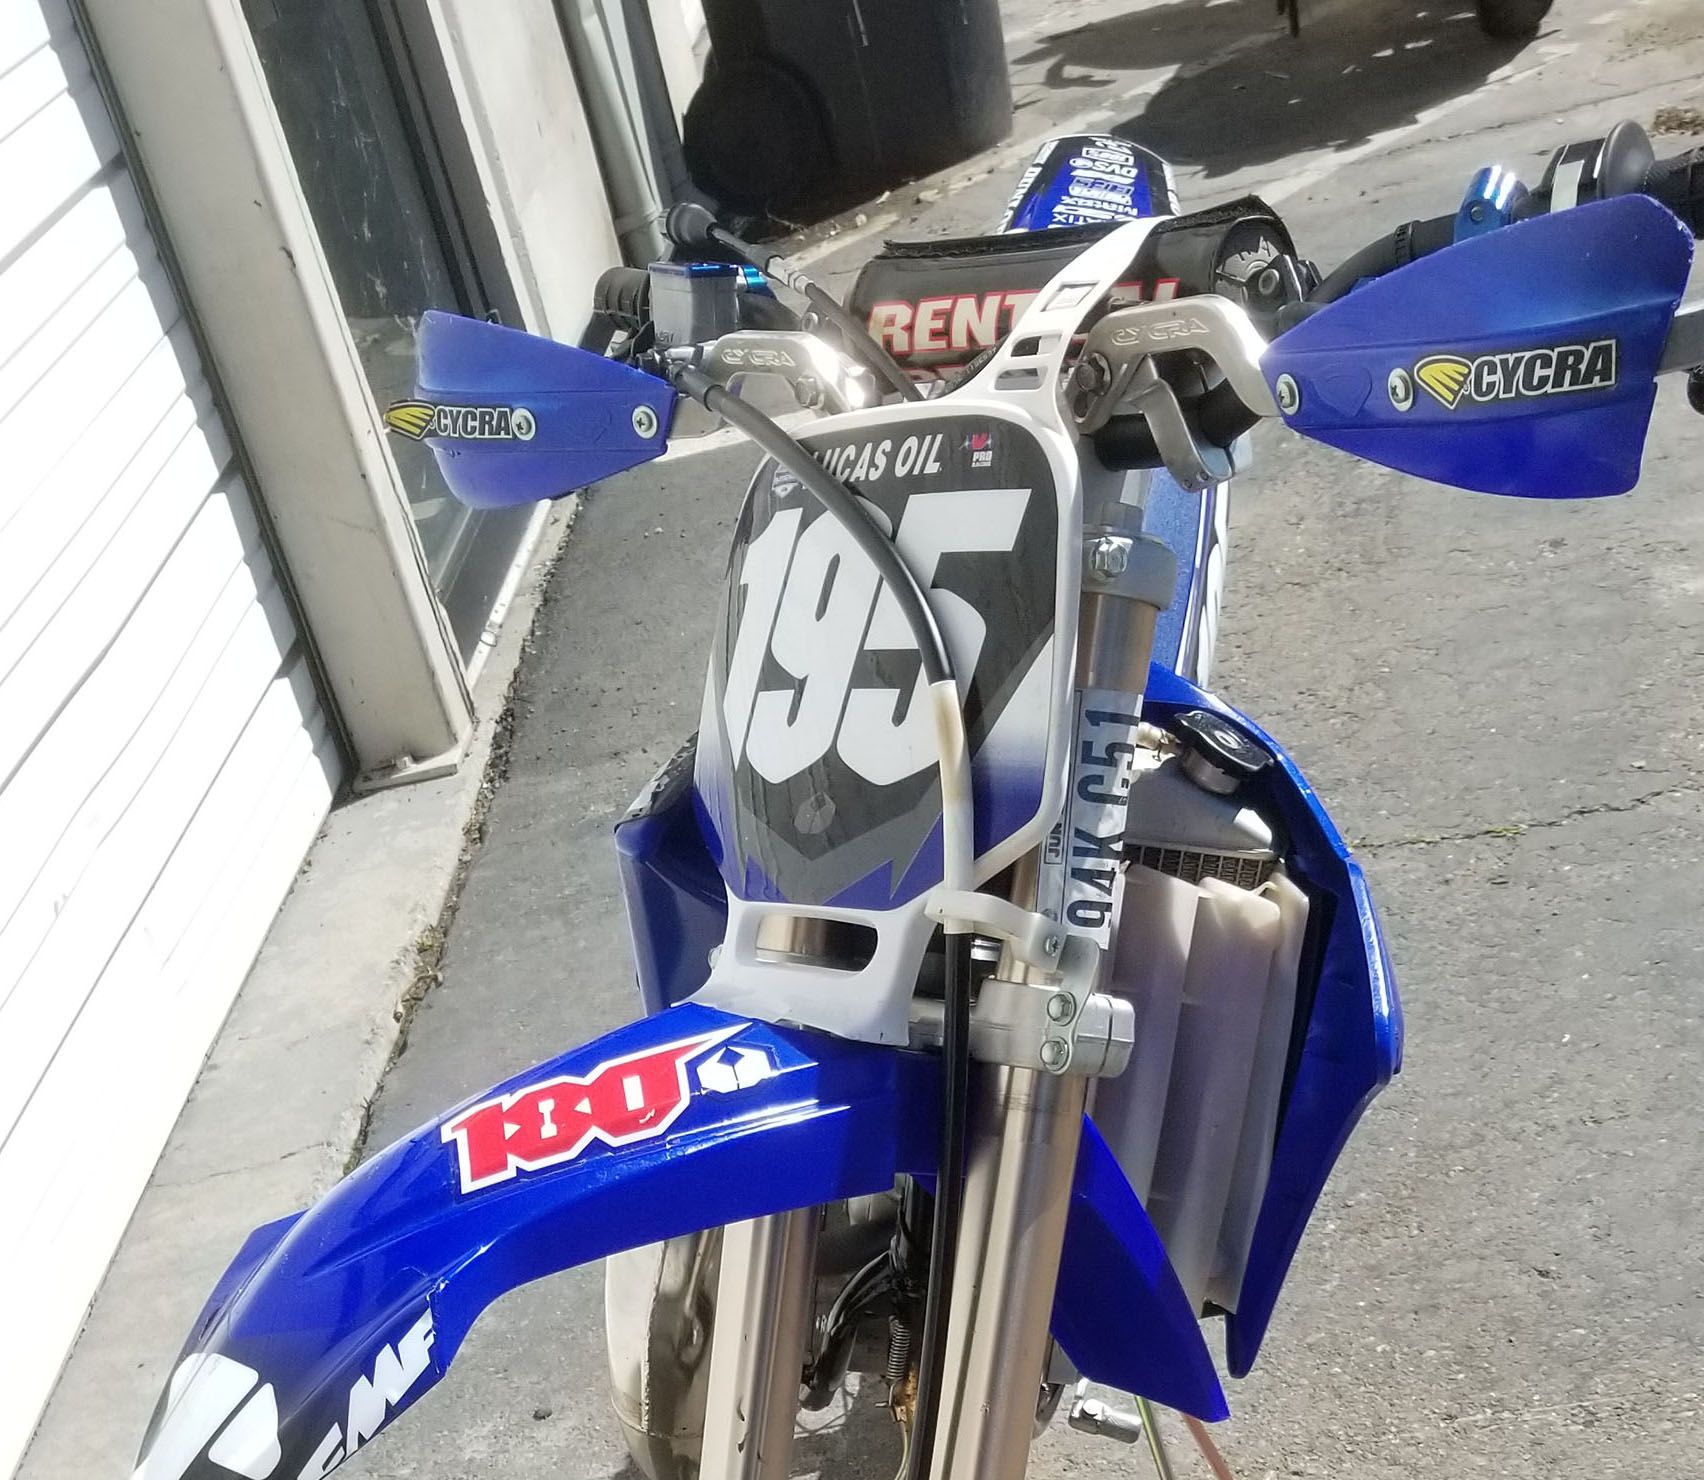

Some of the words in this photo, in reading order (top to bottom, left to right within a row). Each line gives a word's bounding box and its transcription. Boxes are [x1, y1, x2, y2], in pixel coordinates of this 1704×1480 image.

[868, 277, 1182, 358] RENT
[1470, 339, 1616, 402] CYCRA
[436, 405, 513, 440] CYCRA
[814, 440, 892, 482] UCAS
[895, 433, 943, 477] OIL
[723, 488, 1032, 786] 195
[1046, 822, 1063, 857] JUN
